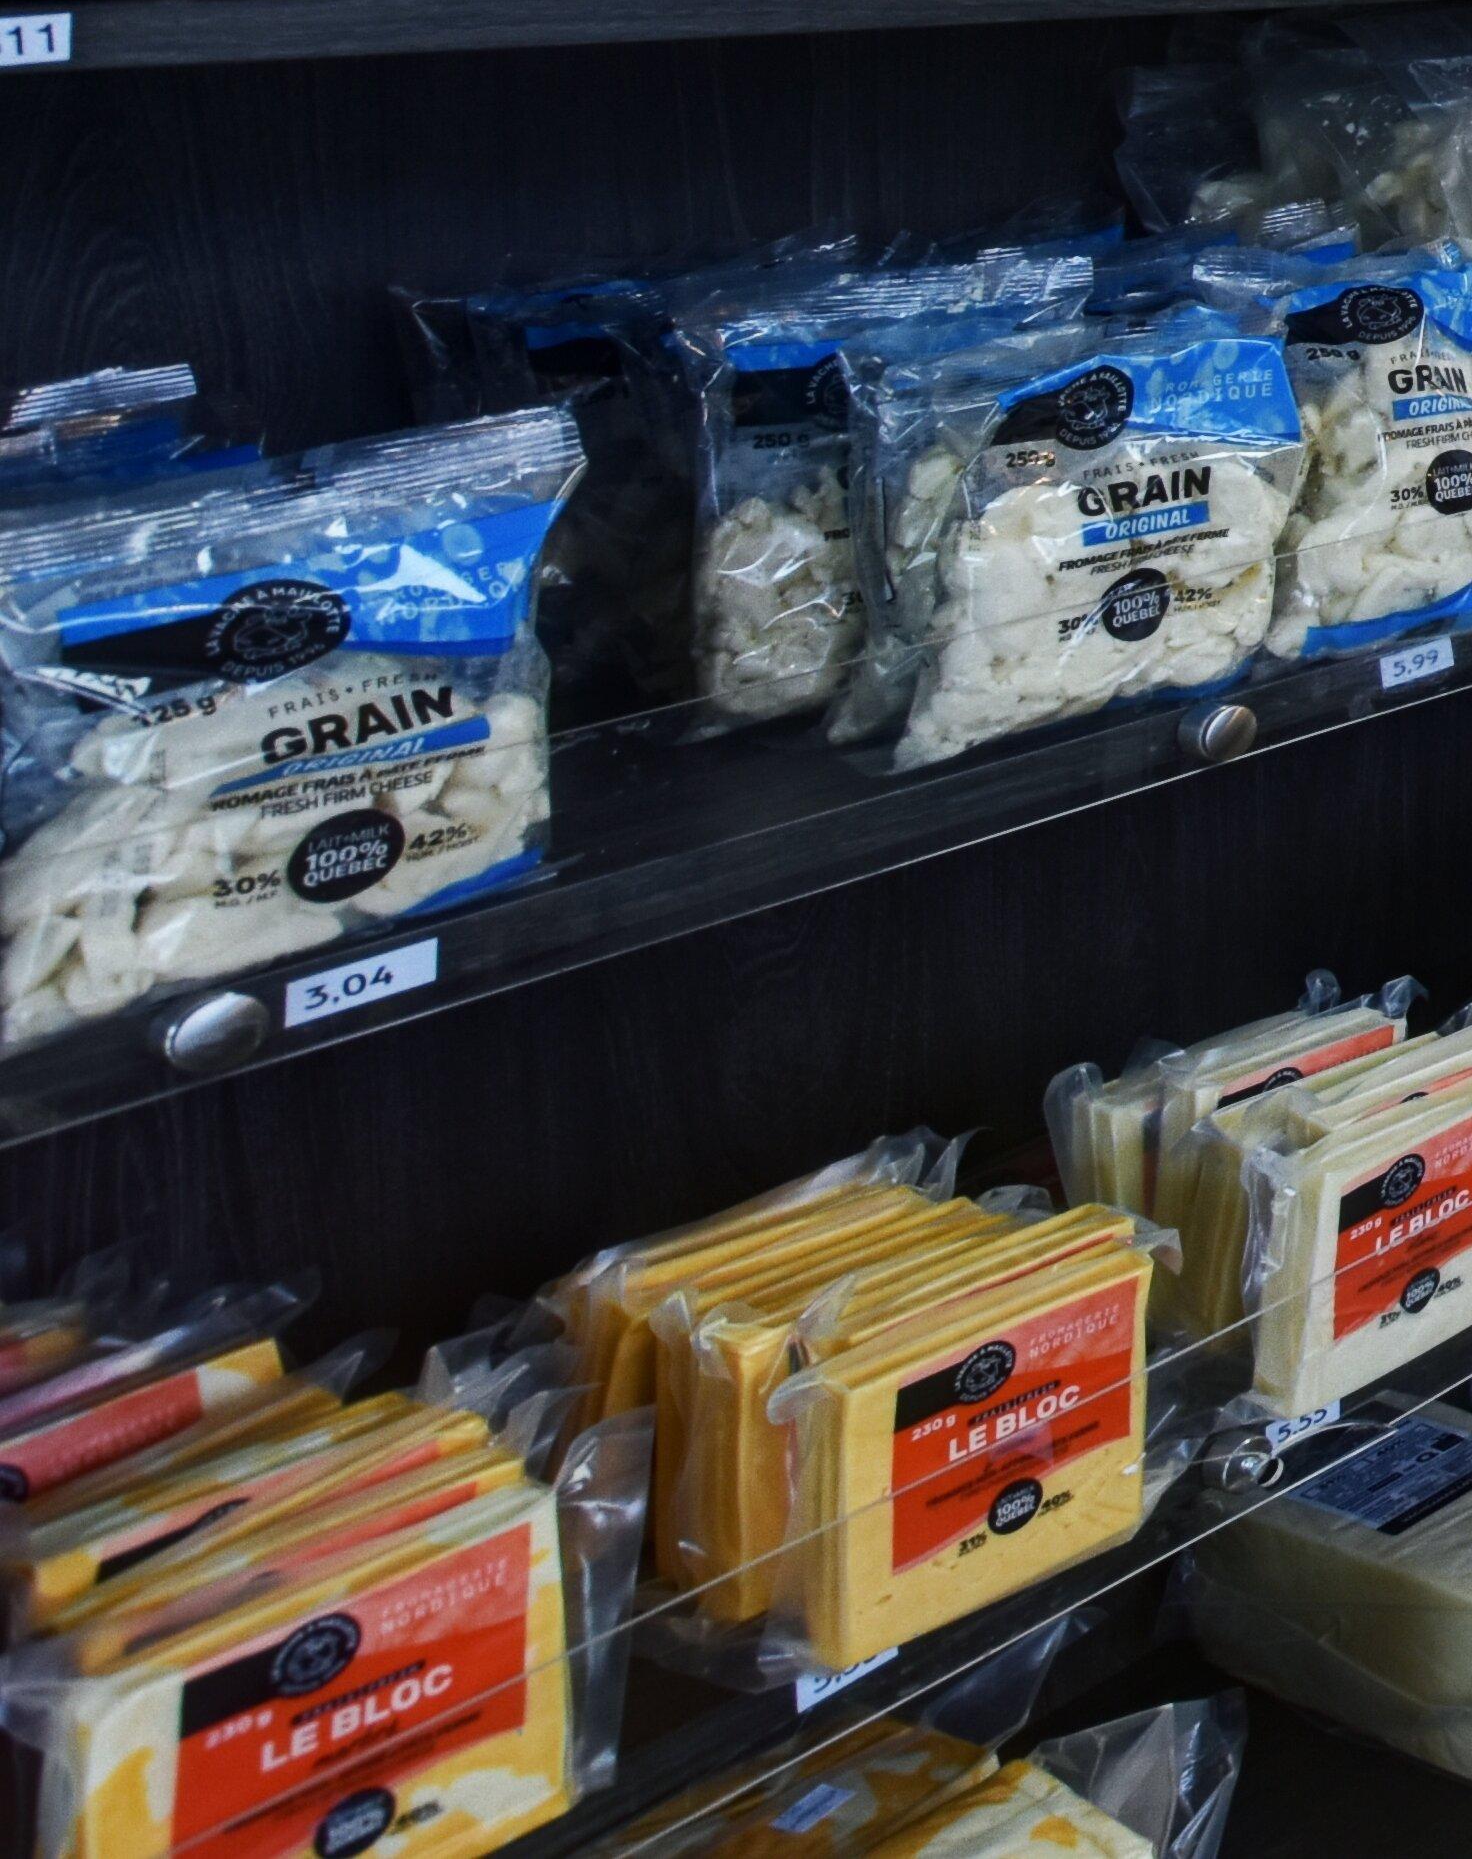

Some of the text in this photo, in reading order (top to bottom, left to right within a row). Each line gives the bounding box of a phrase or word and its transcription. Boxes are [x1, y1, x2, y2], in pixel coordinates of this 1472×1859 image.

[1387, 364, 1470, 395] GRAIN
[1424, 421, 1454, 437] FRAIS
[1083, 451, 1199, 480] FRAIS FRESH
[1077, 466, 1211, 517] GRAIN
[1390, 487, 1424, 502] 30%
[1105, 509, 1191, 540] ORIGINAL
[1058, 549, 1119, 572] FROMAGE
[1113, 592, 1161, 616] 100%
[1393, 649, 1440, 679] 5.99
[268, 687, 340, 719] FRAIS
[260, 686, 455, 764] GRAIN
[260, 770, 434, 820] FRESH FIRM CHEESE
[408, 823, 469, 851] 42%
[304, 840, 389, 872] 100%
[213, 870, 282, 899] 30%
[1350, 1222, 1371, 1241] 230
[1375, 1189, 1471, 1256] LE BLOC
[1029, 1314, 1119, 1359] NORDIQUE
[911, 1413, 958, 1442] 230 g
[949, 1423, 988, 1462] LE
[996, 1384, 1082, 1440] BLOC
[997, 1492, 1036, 1519] 100%
[261, 1663, 454, 1774] LE BLOC
